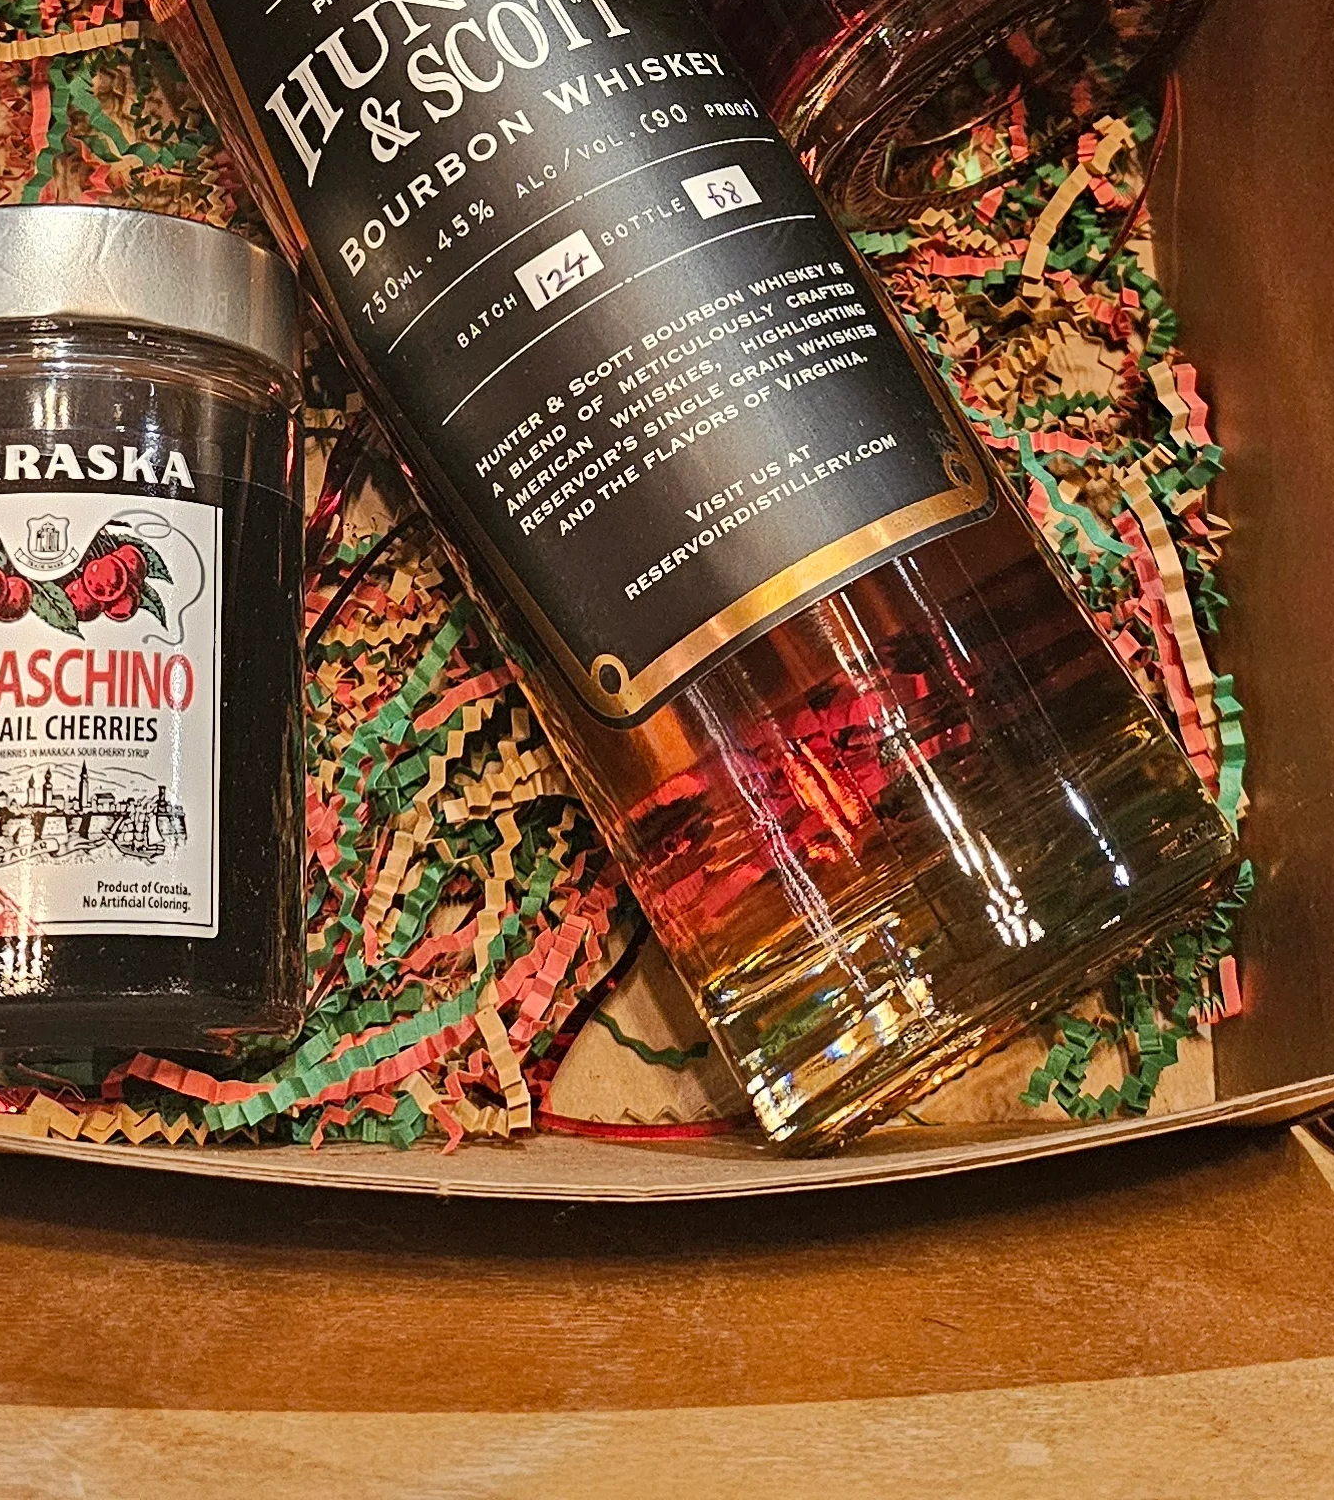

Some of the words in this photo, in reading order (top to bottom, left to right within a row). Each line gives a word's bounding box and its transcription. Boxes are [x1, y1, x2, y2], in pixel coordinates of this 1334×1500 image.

[339, 109, 535, 278] BOURBON
[542, 51, 726, 115] WHISKEY
[359, 96, 421, 164] &
[436, 197, 496, 253] 45%
[639, 104, 688, 135] (90
[703, 98, 759, 118] PROOF)
[456, 292, 519, 350] BATCH
[537, 250, 590, 301] 124
[600, 196, 686, 248] BOTTLE
[474, 412, 545, 478] HUNTER
[546, 395, 565, 415] &
[568, 345, 635, 398] SCOTT
[640, 289, 746, 352] BOURBON
[747, 264, 826, 298] WHISKEY
[827, 261, 845, 276] IS
[491, 482, 505, 498] A
[508, 424, 568, 481] BLEND
[576, 394, 605, 423] OF
[617, 301, 775, 396] METICULOUSLY
[785, 281, 856, 311] CRAFTED
[505, 435, 594, 518] AMERICAN
[609, 358, 723, 431] WHISKIES,
[739, 301, 867, 355] HIGHLIGHTING
[558, 497, 598, 537] AND
[596, 466, 641, 507] THE
[643, 402, 741, 471] FLAVORS
[742, 385, 772, 410] OF
[777, 352, 870, 394] VIRGINIA.
[643, 381, 725, 440] SINGLE
[727, 348, 794, 389] GRAIN
[795, 323, 878, 358] WHISKIES
[623, 433, 899, 601] RESERVOIRDISTILLERY.COM
[684, 480, 746, 525] VISIT
[750, 460, 783, 484] US
[786, 443, 813, 469] AT
[29, 748, 39, 758] IN
[39, 747, 76, 758] MARASCA
[77, 747, 98, 758] SOUR
[98, 747, 126, 758] CHERRY
[126, 748, 150, 760] SYRUP
[44, 714, 158, 743] CHERRIES
[82, 895, 98, 908] No
[99, 895, 146, 908] Artificial
[147, 896, 192, 913] Coloring.
[97, 880, 139, 893] Product
[141, 880, 152, 893] of
[153, 881, 192, 896] Croatia.
